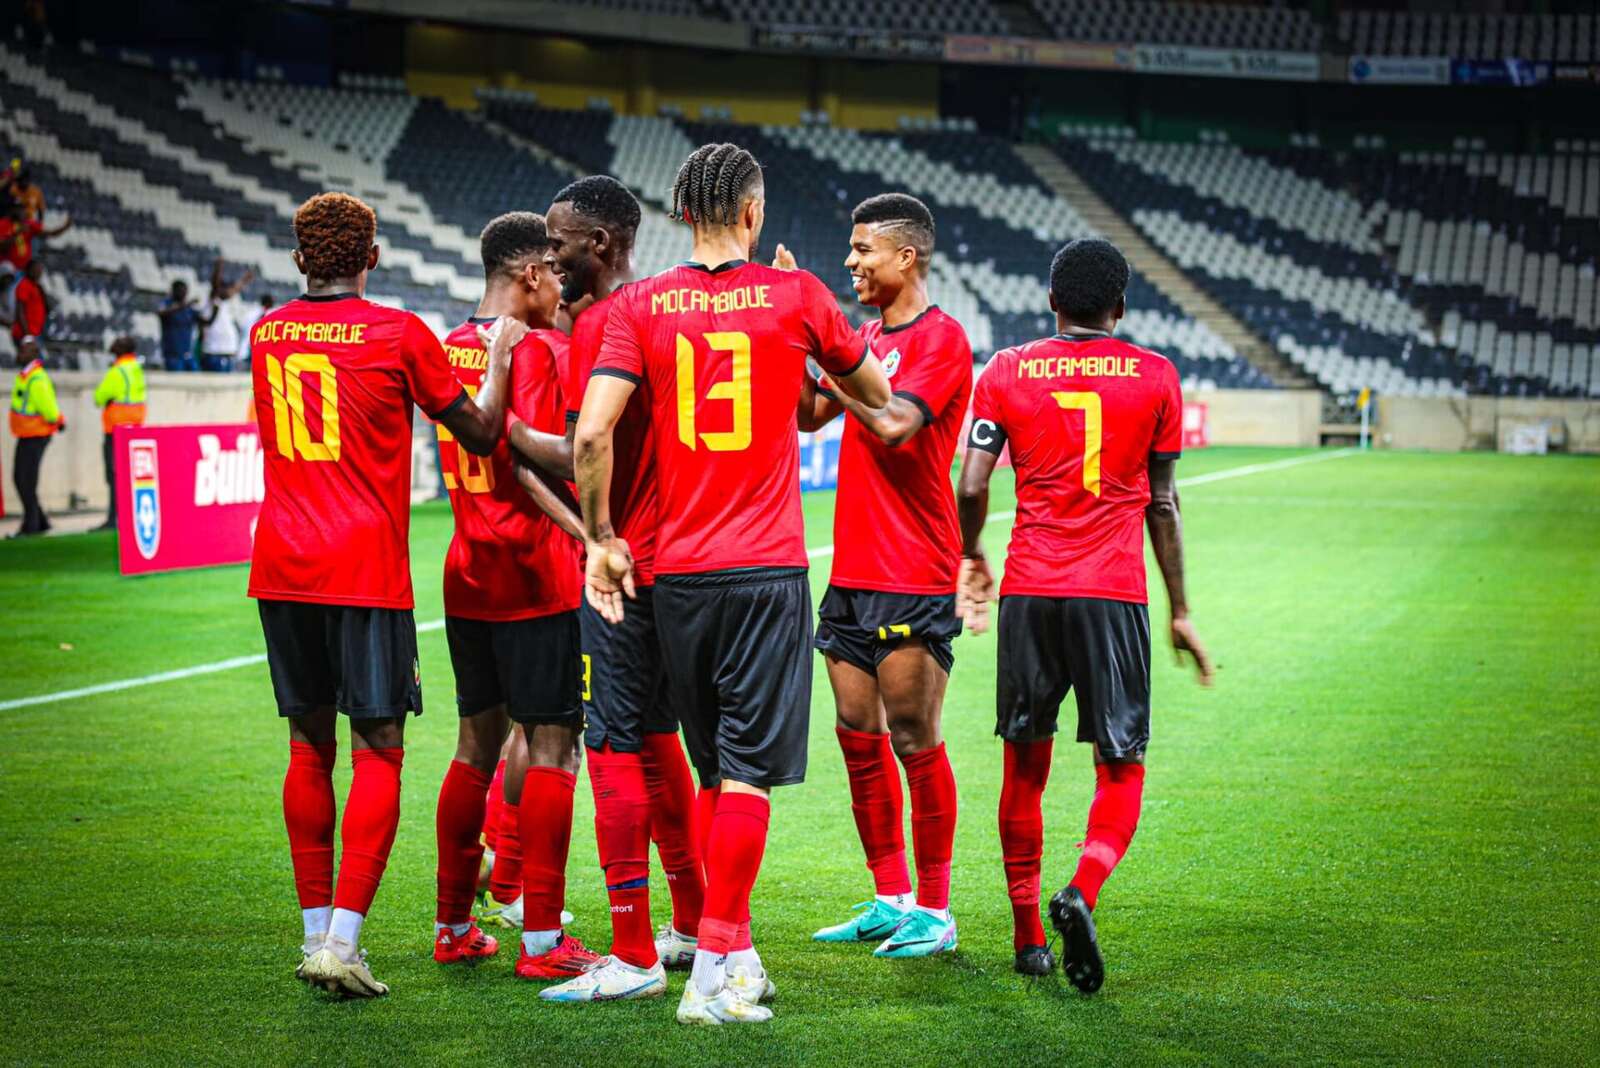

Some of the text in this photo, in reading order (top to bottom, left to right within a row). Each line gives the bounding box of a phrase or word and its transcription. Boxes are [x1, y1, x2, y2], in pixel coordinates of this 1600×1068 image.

[650, 285, 774, 316] MOÇAMBIQUE
[253, 320, 368, 346] MOÇAMBIQUE
[1017, 356, 1141, 380] MOÇAMBIQUE
[265, 352, 341, 462] 10
[675, 331, 752, 452] 13
[971, 418, 996, 446] C
[1050, 391, 1102, 498] 7
